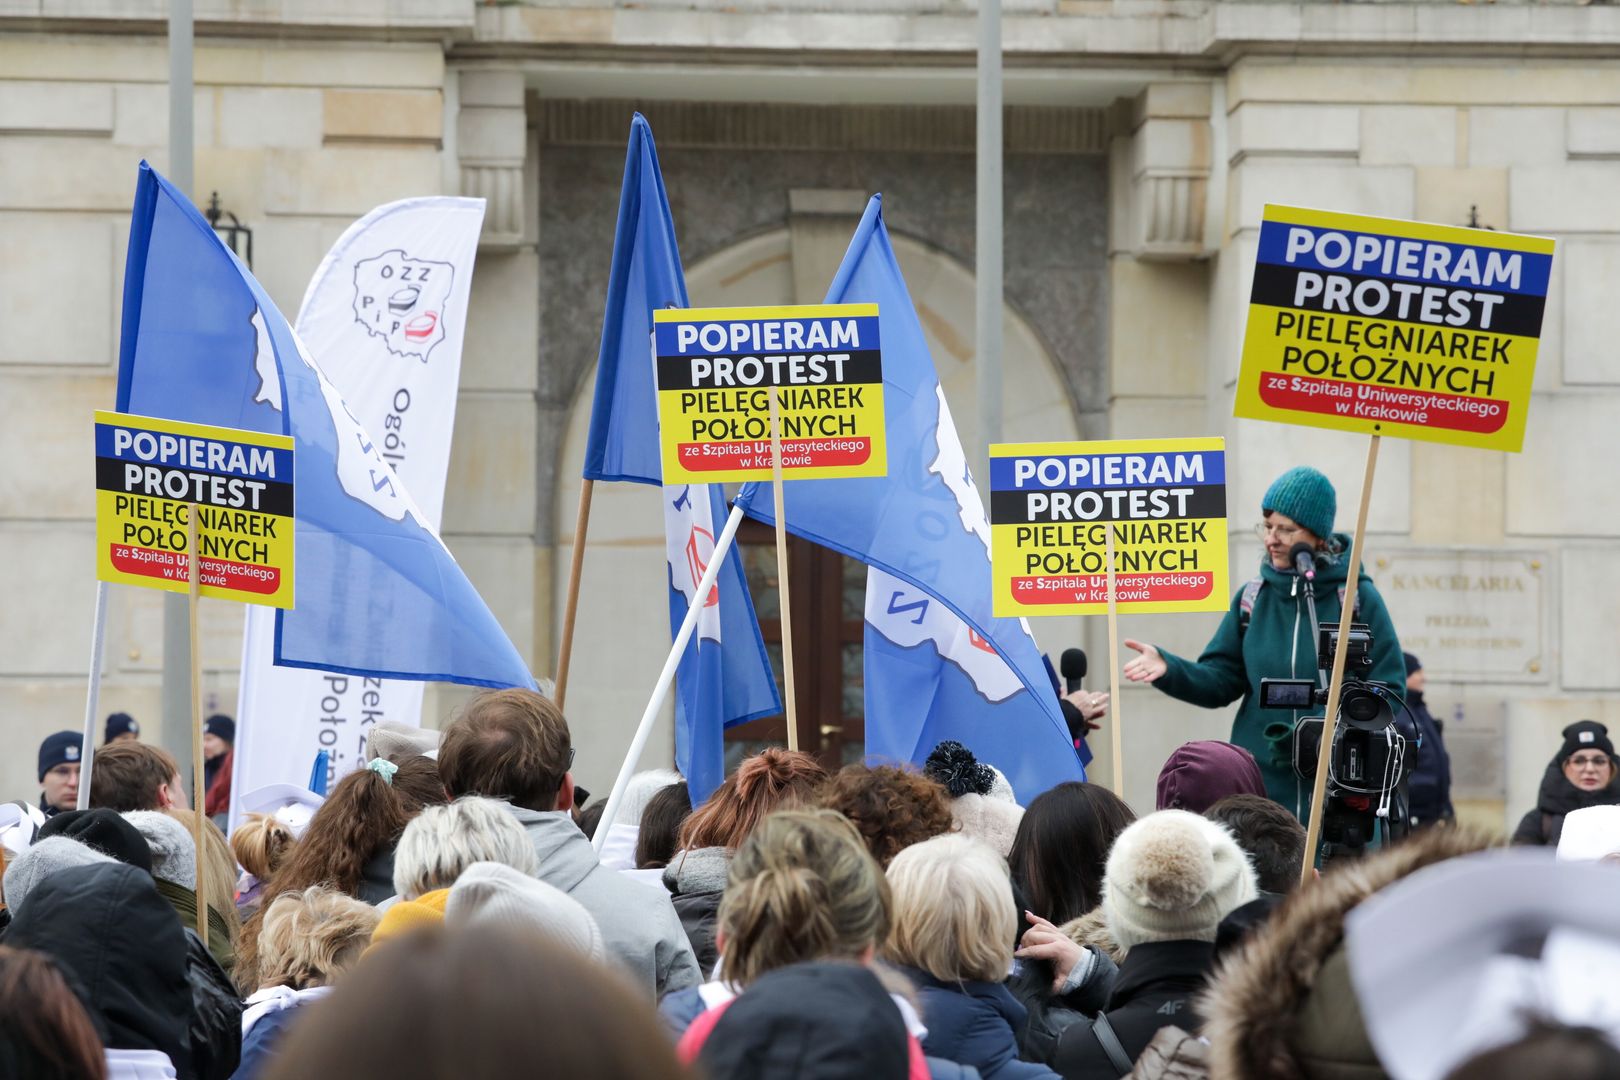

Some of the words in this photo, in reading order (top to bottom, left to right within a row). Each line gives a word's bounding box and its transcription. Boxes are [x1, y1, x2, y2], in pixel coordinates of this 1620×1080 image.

[381, 265, 431, 282] OZZ
[1286, 227, 1522, 290] POPIERAM
[1294, 271, 1504, 329] PROTEST
[678, 320, 860, 353] POPIERAM
[1276, 312, 1512, 364] PIELĘGNIAREK
[690, 354, 850, 386] PROTEST
[1282, 346, 1495, 396] POŁOŻNYCH
[682, 387, 864, 416] PIELĘGNIAREK
[1268, 376, 1287, 390] ze
[1290, 377, 1353, 400] Szpitala
[1357, 386, 1500, 418] Uniwersyteckiego
[1335, 402, 1350, 413] w
[1354, 401, 1428, 423] Krakowie
[114, 428, 276, 478] POPIERAM
[685, 446, 699, 457] ze
[702, 442, 751, 458] Szpitala
[754, 439, 864, 455] Unwersyteckiego
[740, 458, 751, 467] w
[754, 455, 812, 466] Kraowie
[124, 464, 266, 510] PROTEST
[1014, 454, 1204, 488] POPIERAM
[1027, 488, 1194, 522] PROTEST
[124, 522, 268, 564] POŁONYCH
[1016, 522, 1208, 550] PIELĘGNIAREK
[116, 548, 128, 558] ze
[132, 548, 174, 565] Szpitala
[176, 555, 275, 582] Uwersyteckiego
[163, 568, 172, 577] w
[176, 568, 226, 586] Kraowie
[1018, 579, 1032, 590] ze
[1036, 576, 1086, 592] Szpitala
[1090, 574, 1206, 589] Unwersyteckiego
[1075, 591, 1086, 600] w
[1156, 1000, 1185, 1016] 4F
